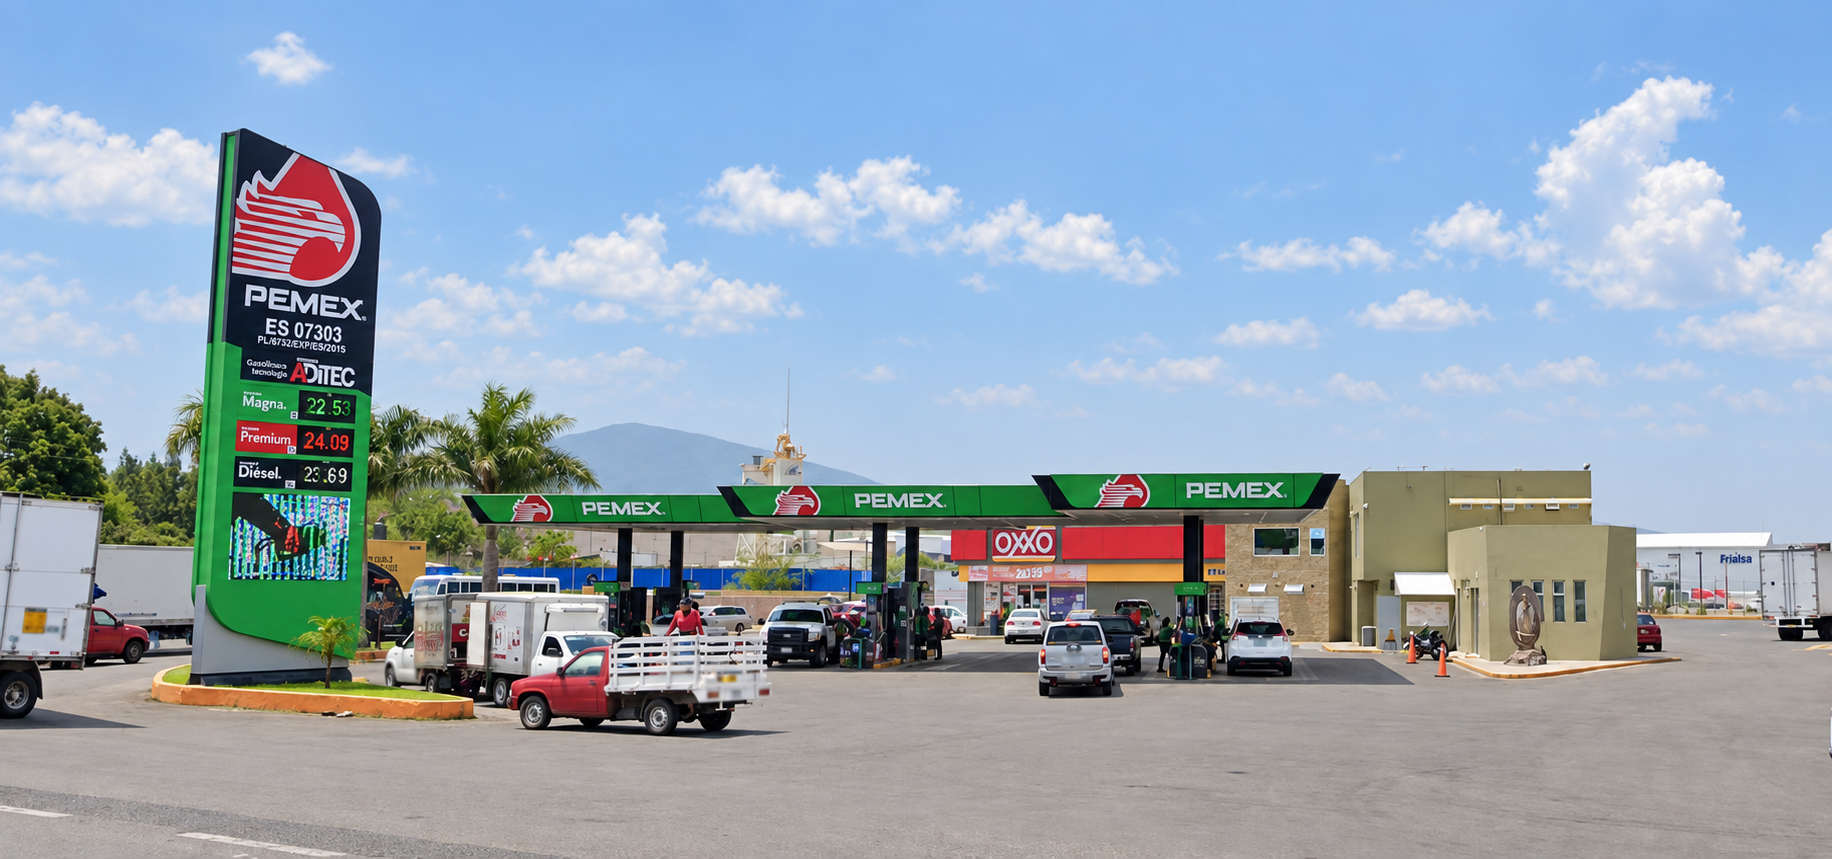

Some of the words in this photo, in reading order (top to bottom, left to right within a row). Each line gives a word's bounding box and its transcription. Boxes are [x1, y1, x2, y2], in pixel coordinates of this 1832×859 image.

[244, 284, 363, 321] PEMEX
[265, 318, 289, 337] ES
[294, 321, 342, 343] 07303
[304, 397, 351, 417] 22.53
[240, 430, 291, 446] Premium
[303, 431, 350, 452] 24.09
[303, 466, 348, 484] 23.69
[1186, 482, 1284, 499] PEMEX
[581, 501, 663, 516] PEMEX
[854, 493, 943, 508] PEMEX
[995, 526, 1054, 557] OXXO
[1720, 552, 1753, 564] Frialsa
